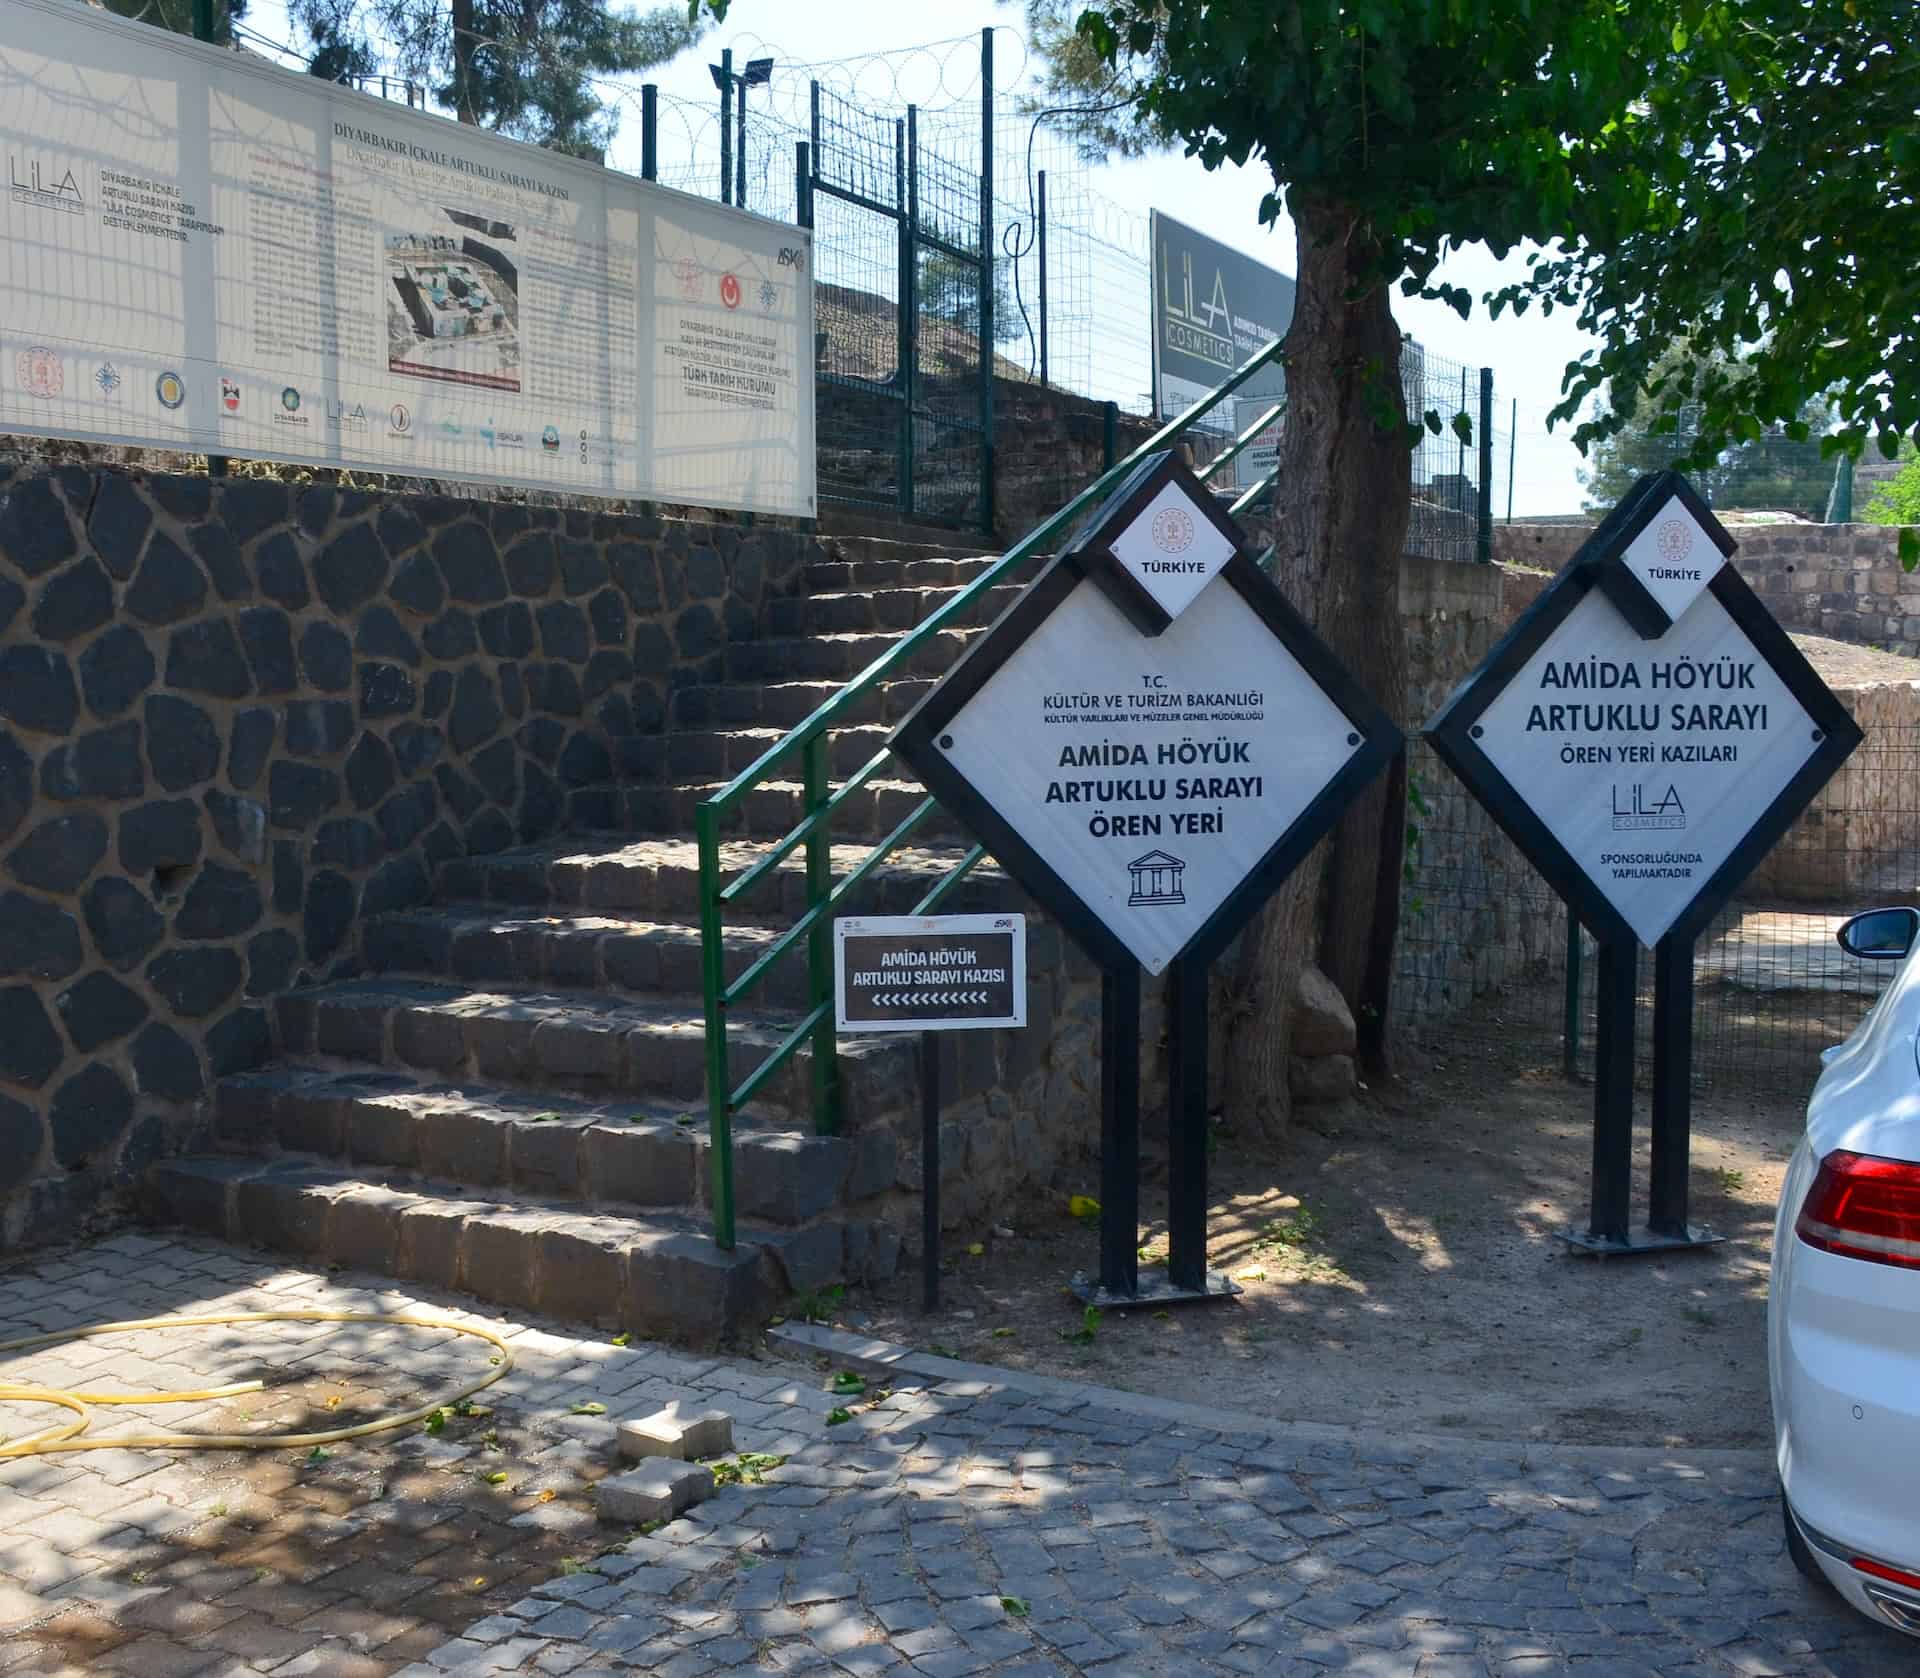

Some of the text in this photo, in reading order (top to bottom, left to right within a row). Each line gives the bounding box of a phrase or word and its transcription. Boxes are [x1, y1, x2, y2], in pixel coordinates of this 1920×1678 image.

[334, 121, 408, 156] DİYARBAKIR
[449, 156, 498, 180] ARTUKLU
[500, 170, 536, 192] SARAYI
[537, 180, 569, 200] KAZISI
[1168, 323, 1232, 362] COSMETICS
[682, 363, 708, 384] TÜRK
[736, 375, 776, 395] KURUMU
[1142, 560, 1205, 573] TÜRKİYE
[1648, 567, 1701, 580] TÜRKİYE
[1142, 676, 1168, 688] T.C.
[1540, 655, 1755, 689] AMİDA HÖYÜK
[1043, 690, 1263, 709] KÜLTÜR VE TURİZM BAKANLIĞI
[1044, 713, 1078, 723] KÜLTÜR
[1080, 714, 1128, 723] VARLIKLARI
[1130, 713, 1141, 722] VE
[1143, 712, 1180, 721] MÜZELER
[1183, 713, 1208, 721] GENEL
[1525, 704, 1767, 731] ARTUKLU SARAYI
[1059, 737, 1250, 767] AMİDA HÖYÜK
[1560, 742, 1737, 763] ÖREN YERİ KAZILARI
[1045, 777, 1262, 803] ARTUKLU SARAYI
[1089, 806, 1223, 838] ÖREN YERİ
[1612, 867, 1692, 879] YAPILMAKTADIR
[881, 947, 976, 967] AMİDA HÖYÜK
[853, 968, 1005, 986] ARTUKLU SARAYI KAZISI
